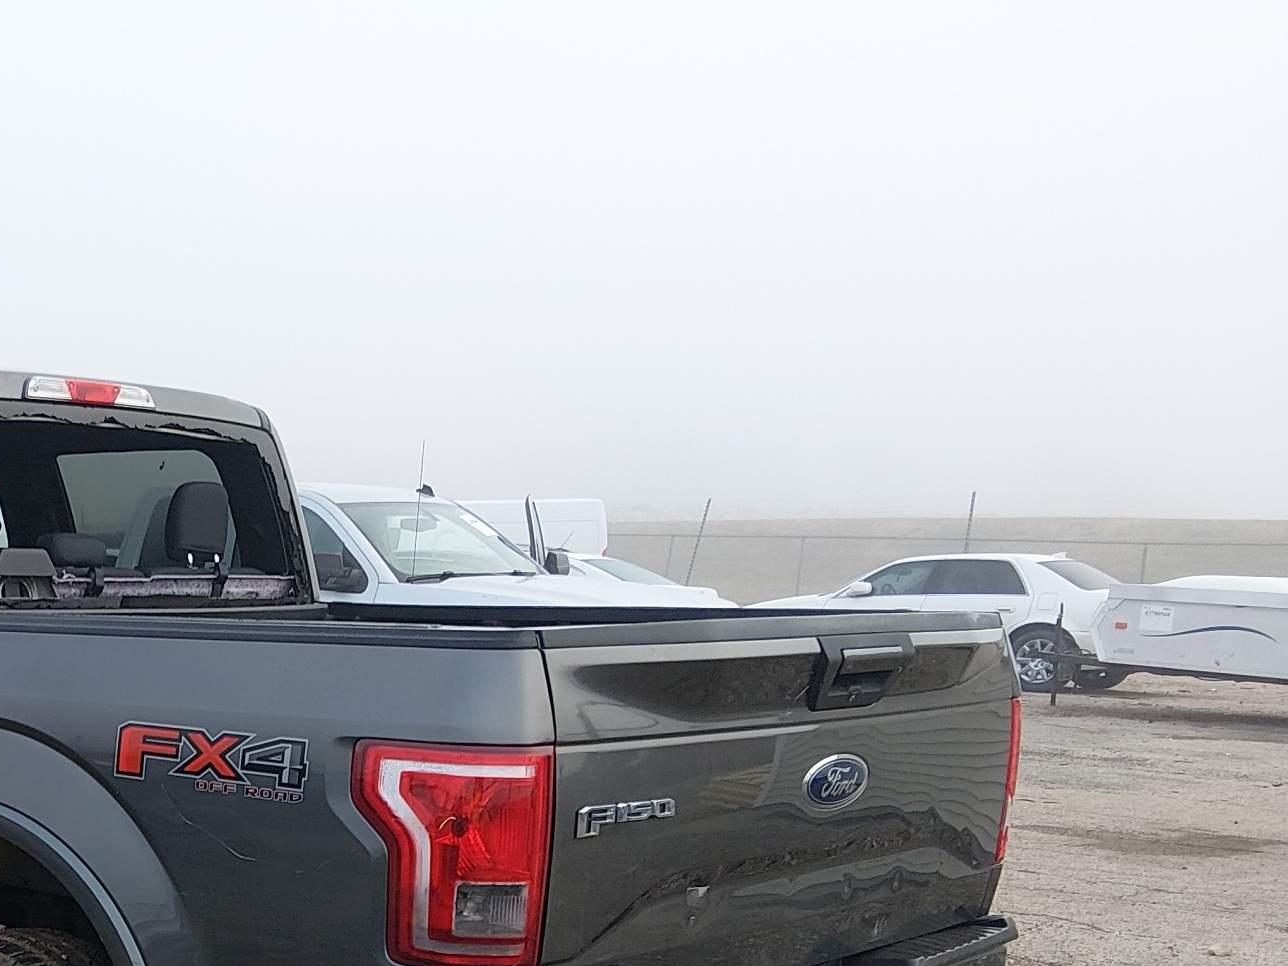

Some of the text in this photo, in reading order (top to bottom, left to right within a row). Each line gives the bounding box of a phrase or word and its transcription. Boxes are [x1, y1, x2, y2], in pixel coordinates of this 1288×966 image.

[114, 720, 310, 791] FX4
[194, 779, 305, 804] OFF ROAD
[820, 766, 859, 798] Ford
